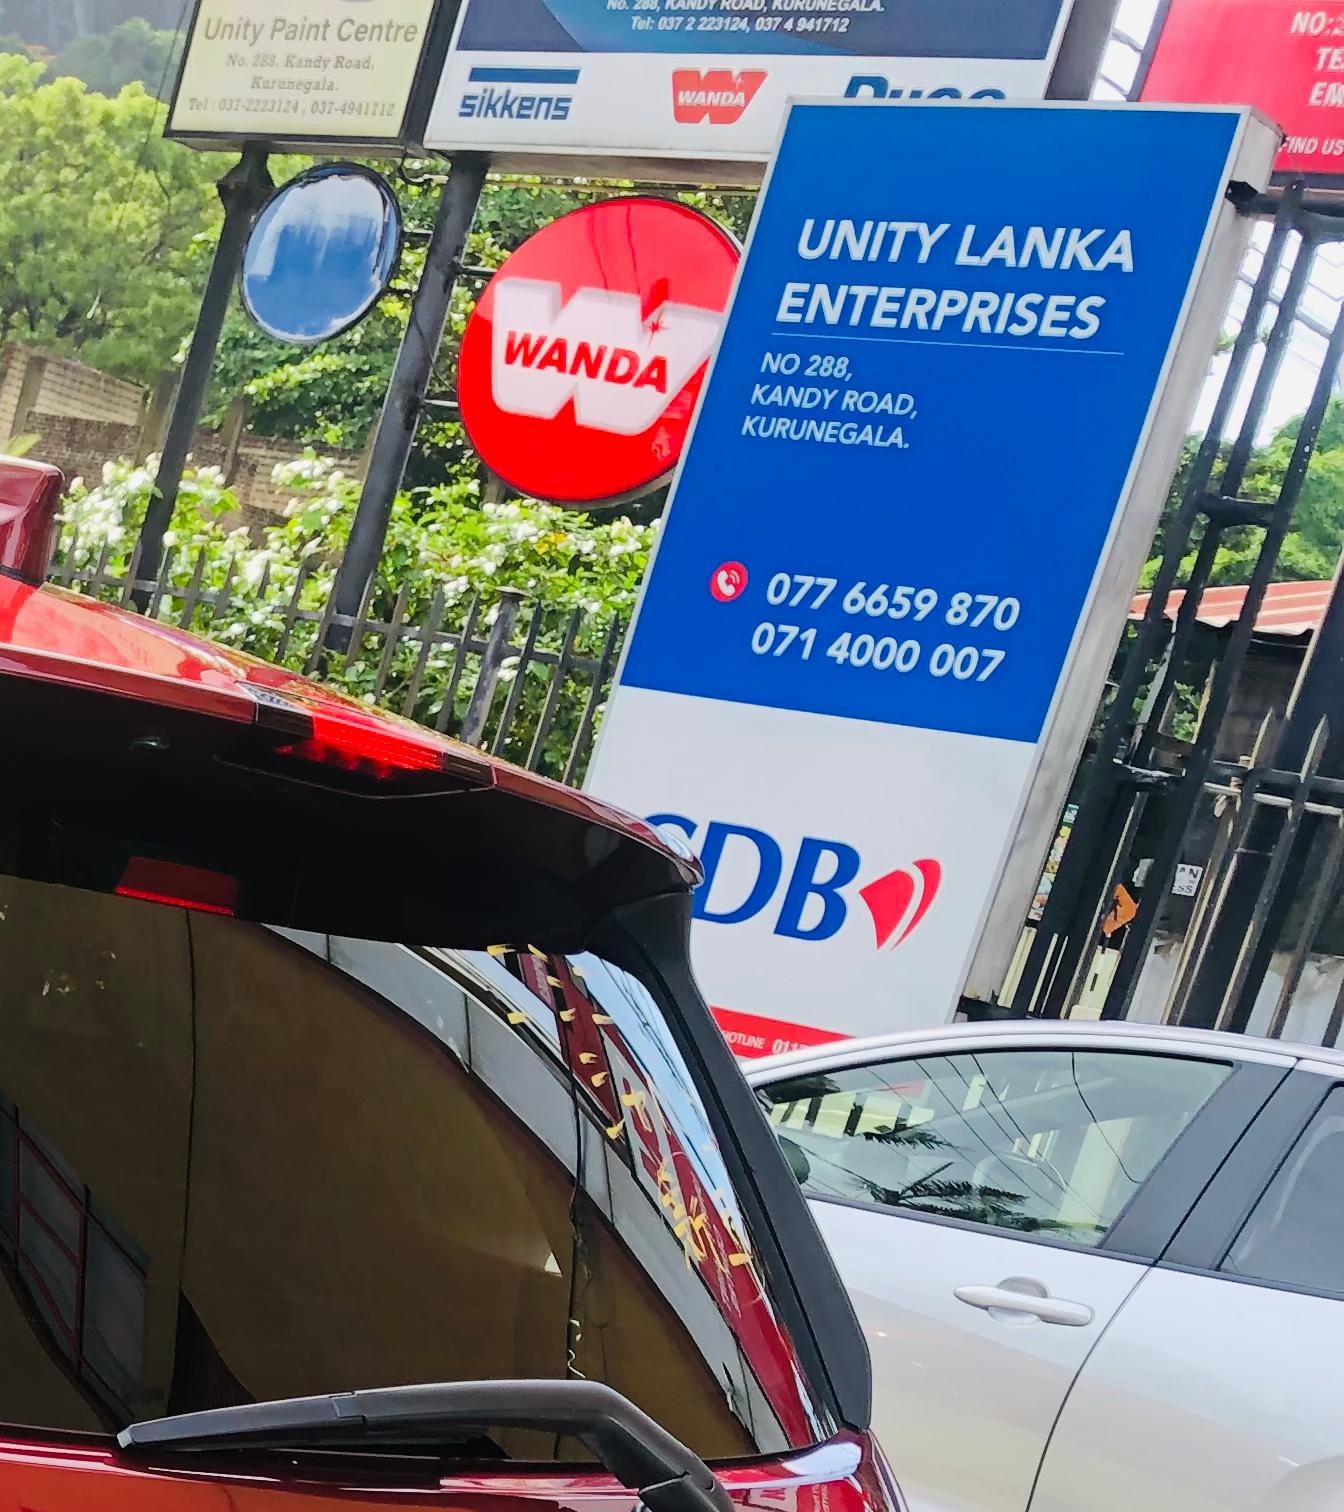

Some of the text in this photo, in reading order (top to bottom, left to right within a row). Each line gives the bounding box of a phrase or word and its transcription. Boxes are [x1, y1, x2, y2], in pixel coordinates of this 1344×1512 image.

[665, 0, 718, 10] KANDY
[719, 0, 768, 12] ROAD,
[204, 16, 418, 46] Unity Paint Centre
[631, 16, 850, 33] Tel: 037 2 223124, 037 4 941712
[285, 54, 331, 72] Kandy
[333, 57, 375, 71] Road,
[251, 76, 339, 94] Kurunegala.
[678, 90, 745, 107] WANDA
[459, 87, 573, 121] sikkens
[797, 218, 1134, 272] UNITY LANKA
[776, 282, 1107, 339] ENTERPRISES
[504, 330, 667, 394] WANDA
[760, 351, 853, 382] NO 288,
[750, 384, 918, 419] KANDY ROAD,
[741, 415, 910, 449] KURUNEGALA.
[766, 572, 1021, 631] 077 6659 870
[751, 622, 1006, 682] 071 4000 007
